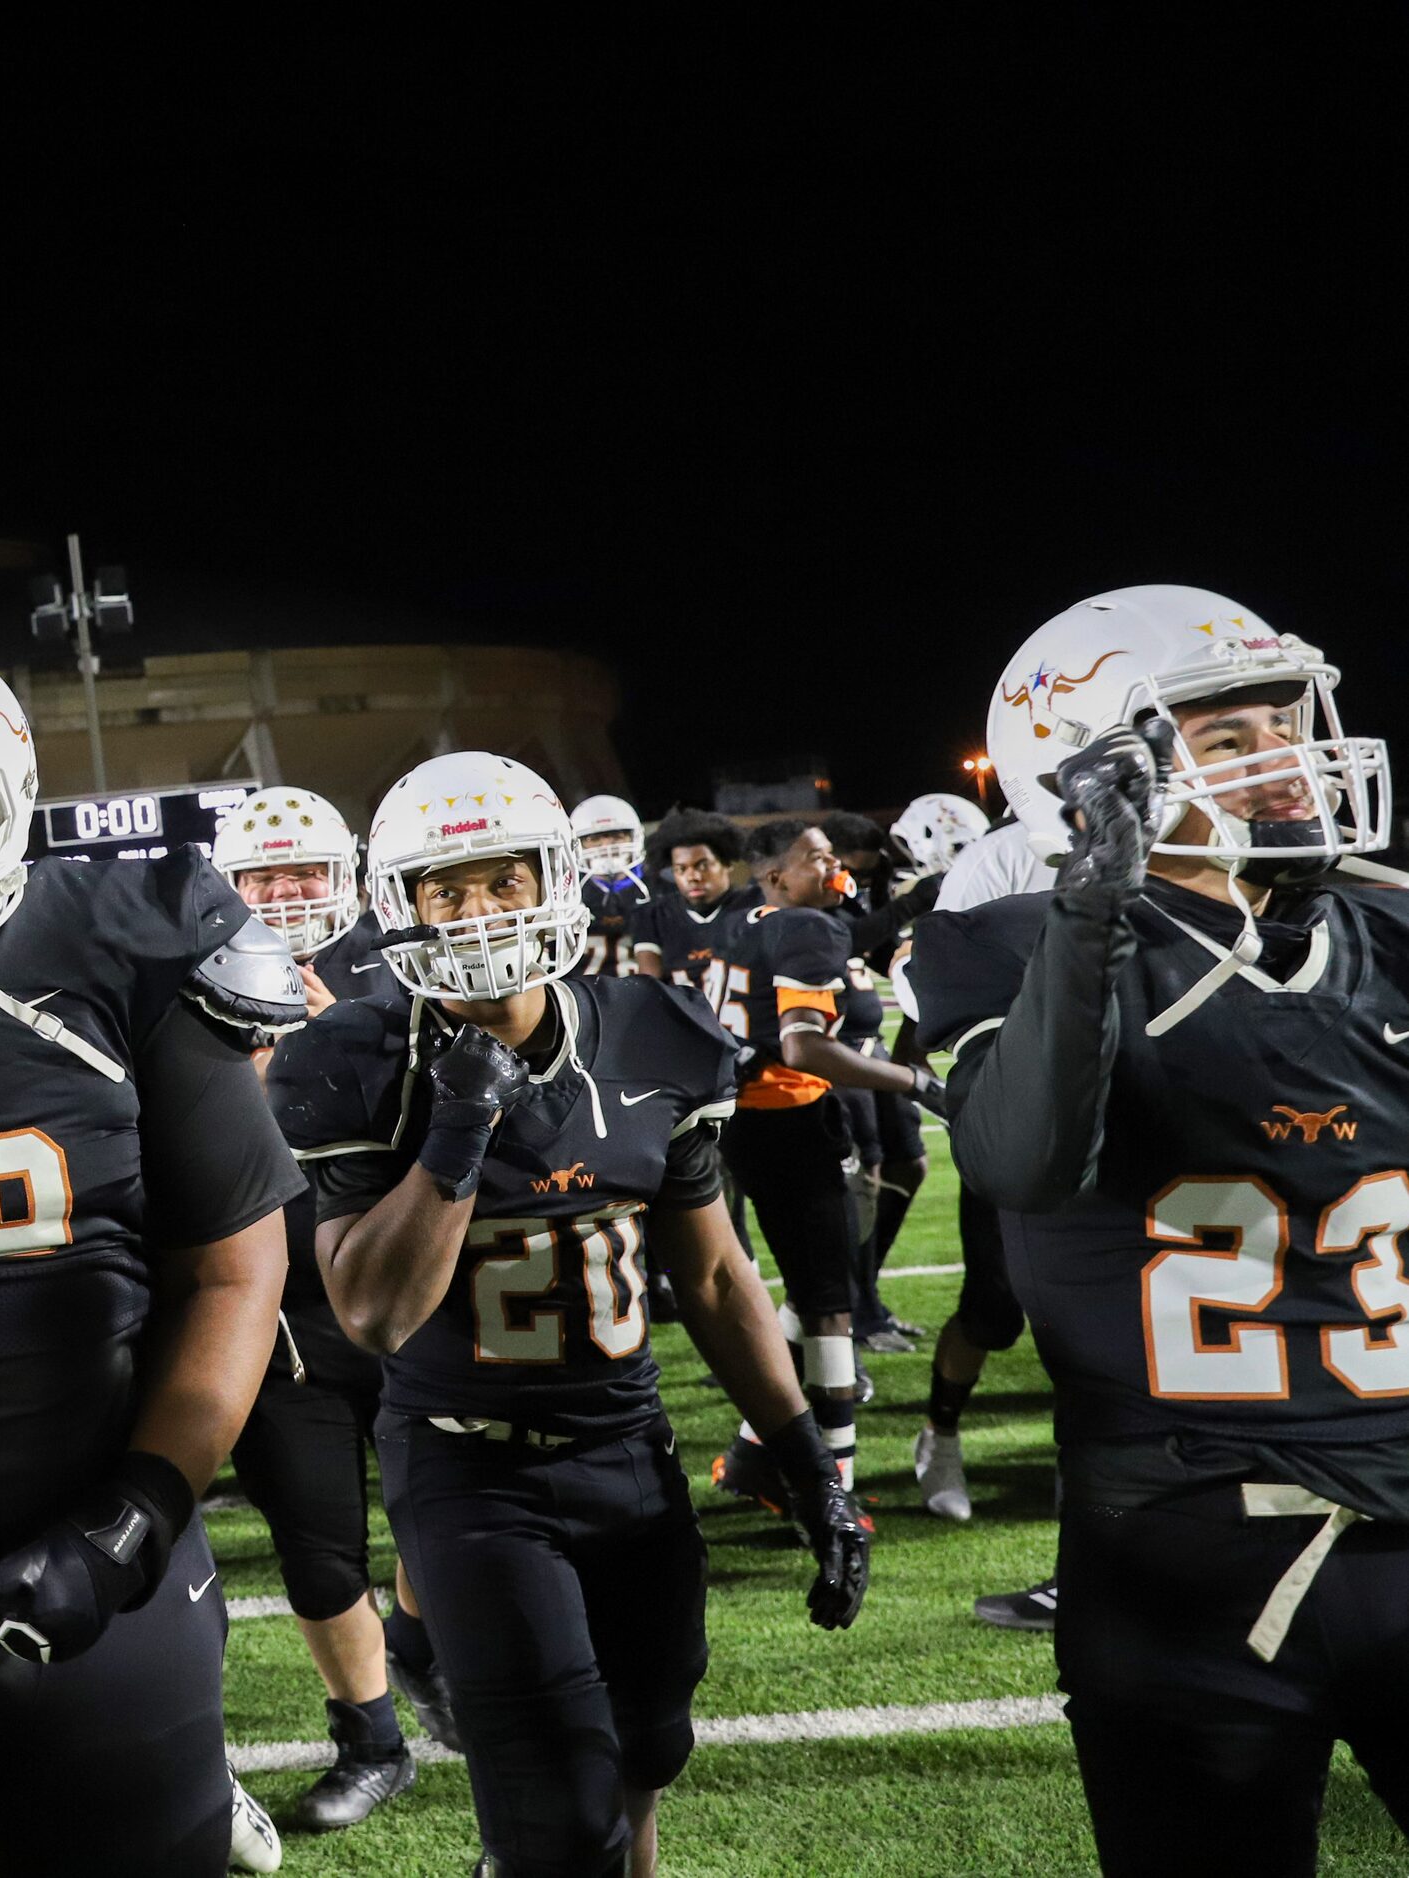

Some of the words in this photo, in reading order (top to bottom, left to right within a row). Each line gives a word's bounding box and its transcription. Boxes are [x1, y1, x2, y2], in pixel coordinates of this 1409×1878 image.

[75, 796, 158, 839] 0:00
[441, 818, 487, 836] Riddell
[462, 962, 486, 971] Ridde
[467, 1200, 649, 1365] 20
[1141, 1170, 1409, 1401] 23
